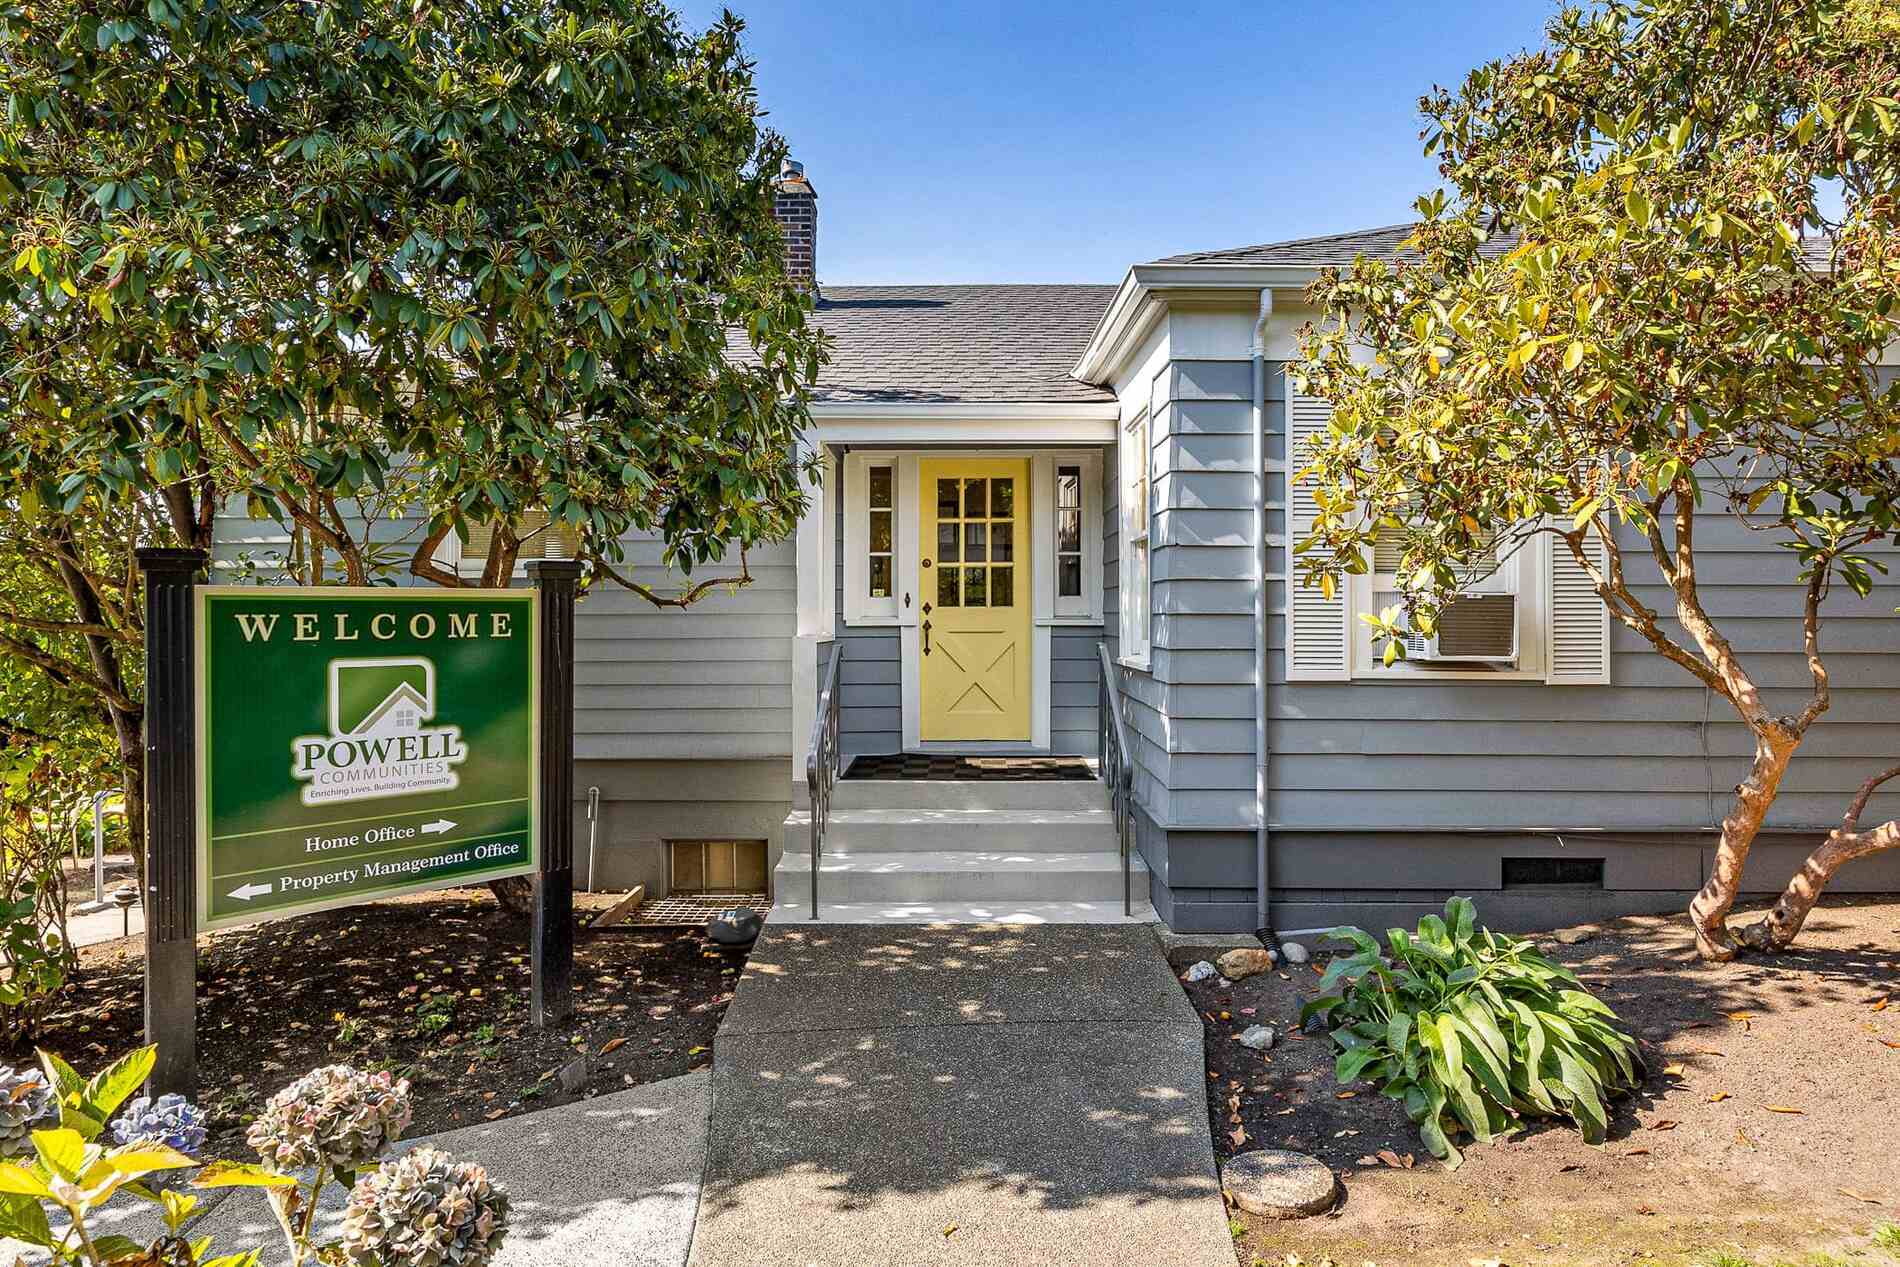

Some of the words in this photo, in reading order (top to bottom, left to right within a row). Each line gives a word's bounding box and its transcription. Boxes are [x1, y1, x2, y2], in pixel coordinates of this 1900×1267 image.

[234, 613, 512, 643] WELCOME
[302, 733, 461, 771] POWELL
[310, 787, 350, 798] Enriching
[374, 780, 405, 792] Building
[407, 776, 450, 789] Community
[320, 761, 444, 785] COMMUNITIES
[304, 836, 359, 853] Home
[365, 825, 416, 844] Office
[280, 869, 359, 892] Property
[364, 849, 470, 877] Management
[474, 842, 520, 859] Office
